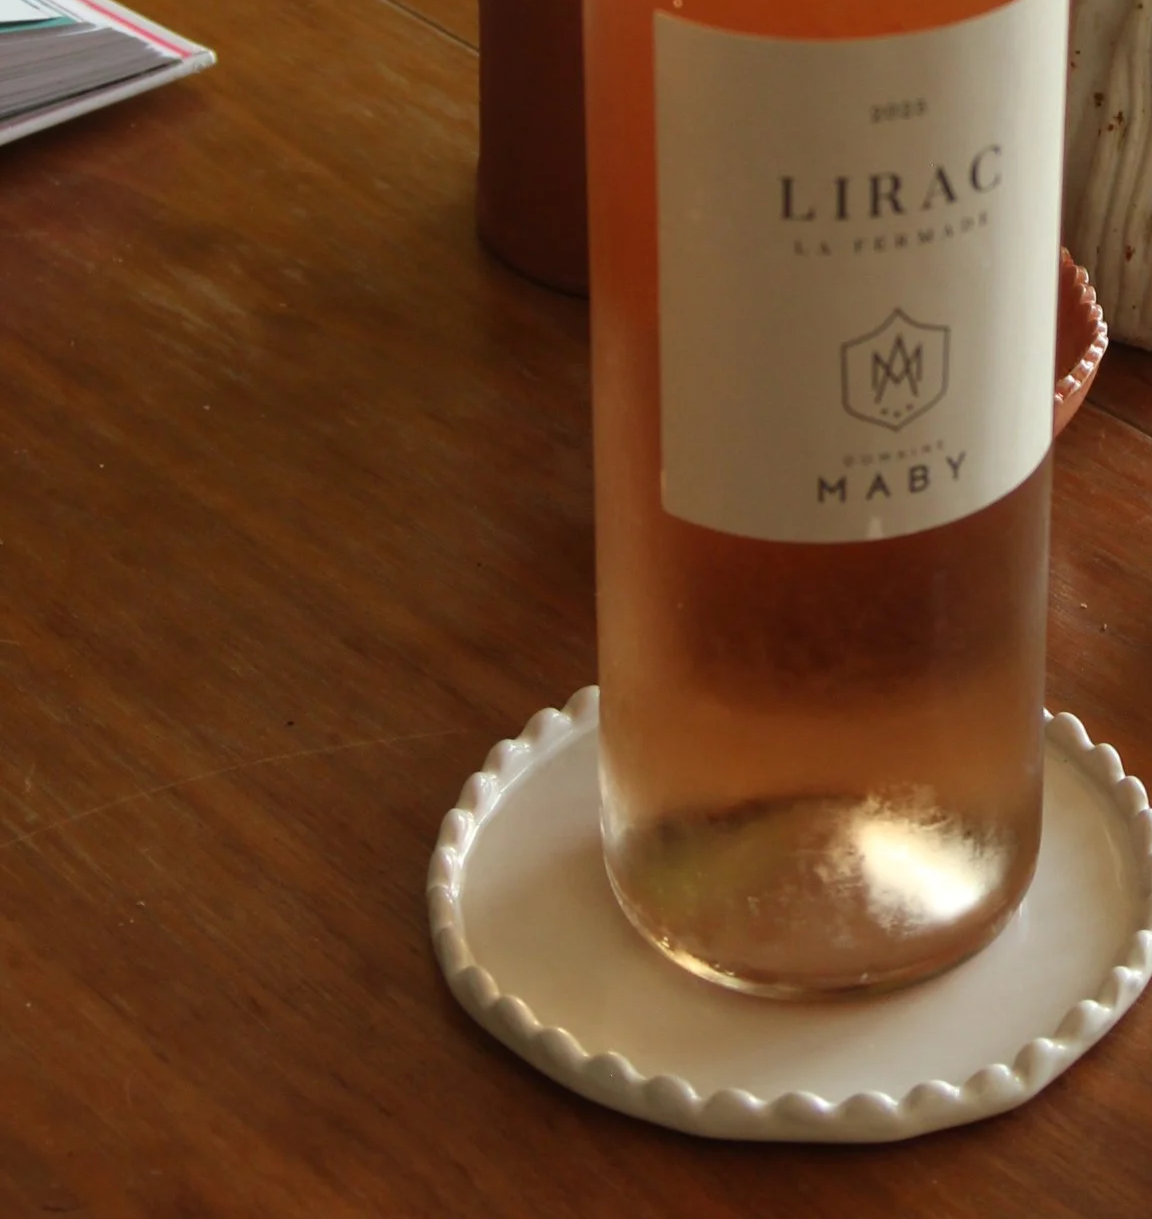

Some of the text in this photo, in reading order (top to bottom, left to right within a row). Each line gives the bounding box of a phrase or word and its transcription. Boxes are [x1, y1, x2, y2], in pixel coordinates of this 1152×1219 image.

[780, 144, 1002, 221] LIRAC
[793, 210, 988, 257] LA FERMADE
[817, 450, 967, 504] MABY
